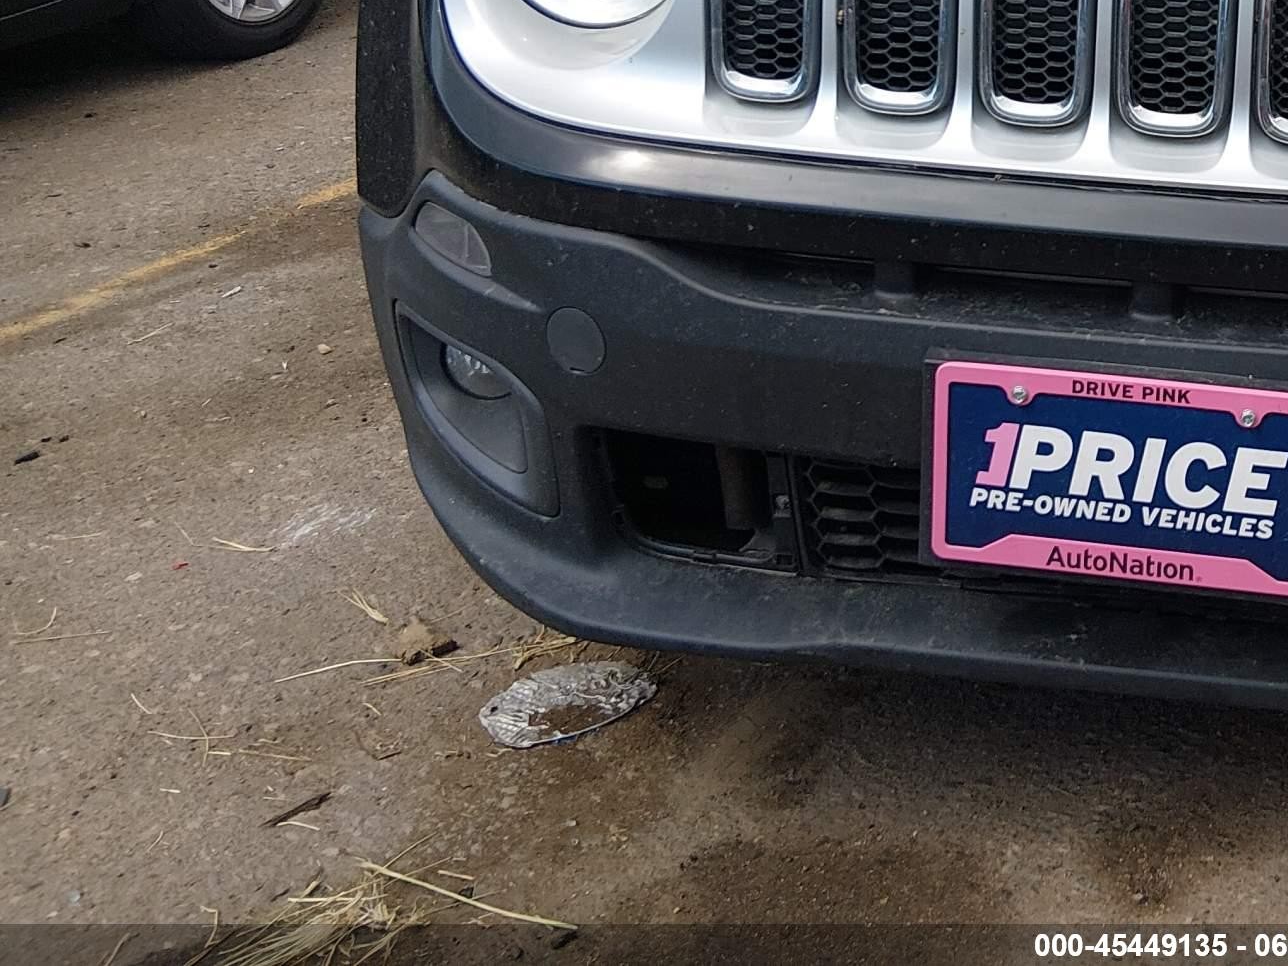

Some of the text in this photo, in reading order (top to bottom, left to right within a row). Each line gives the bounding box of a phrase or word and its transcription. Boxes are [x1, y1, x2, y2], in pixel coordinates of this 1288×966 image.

[1071, 379, 1192, 405] DRIVE PINK
[969, 487, 1275, 540] PRE-OWNED VEHICLES
[1045, 545, 1195, 582] AutoNation
